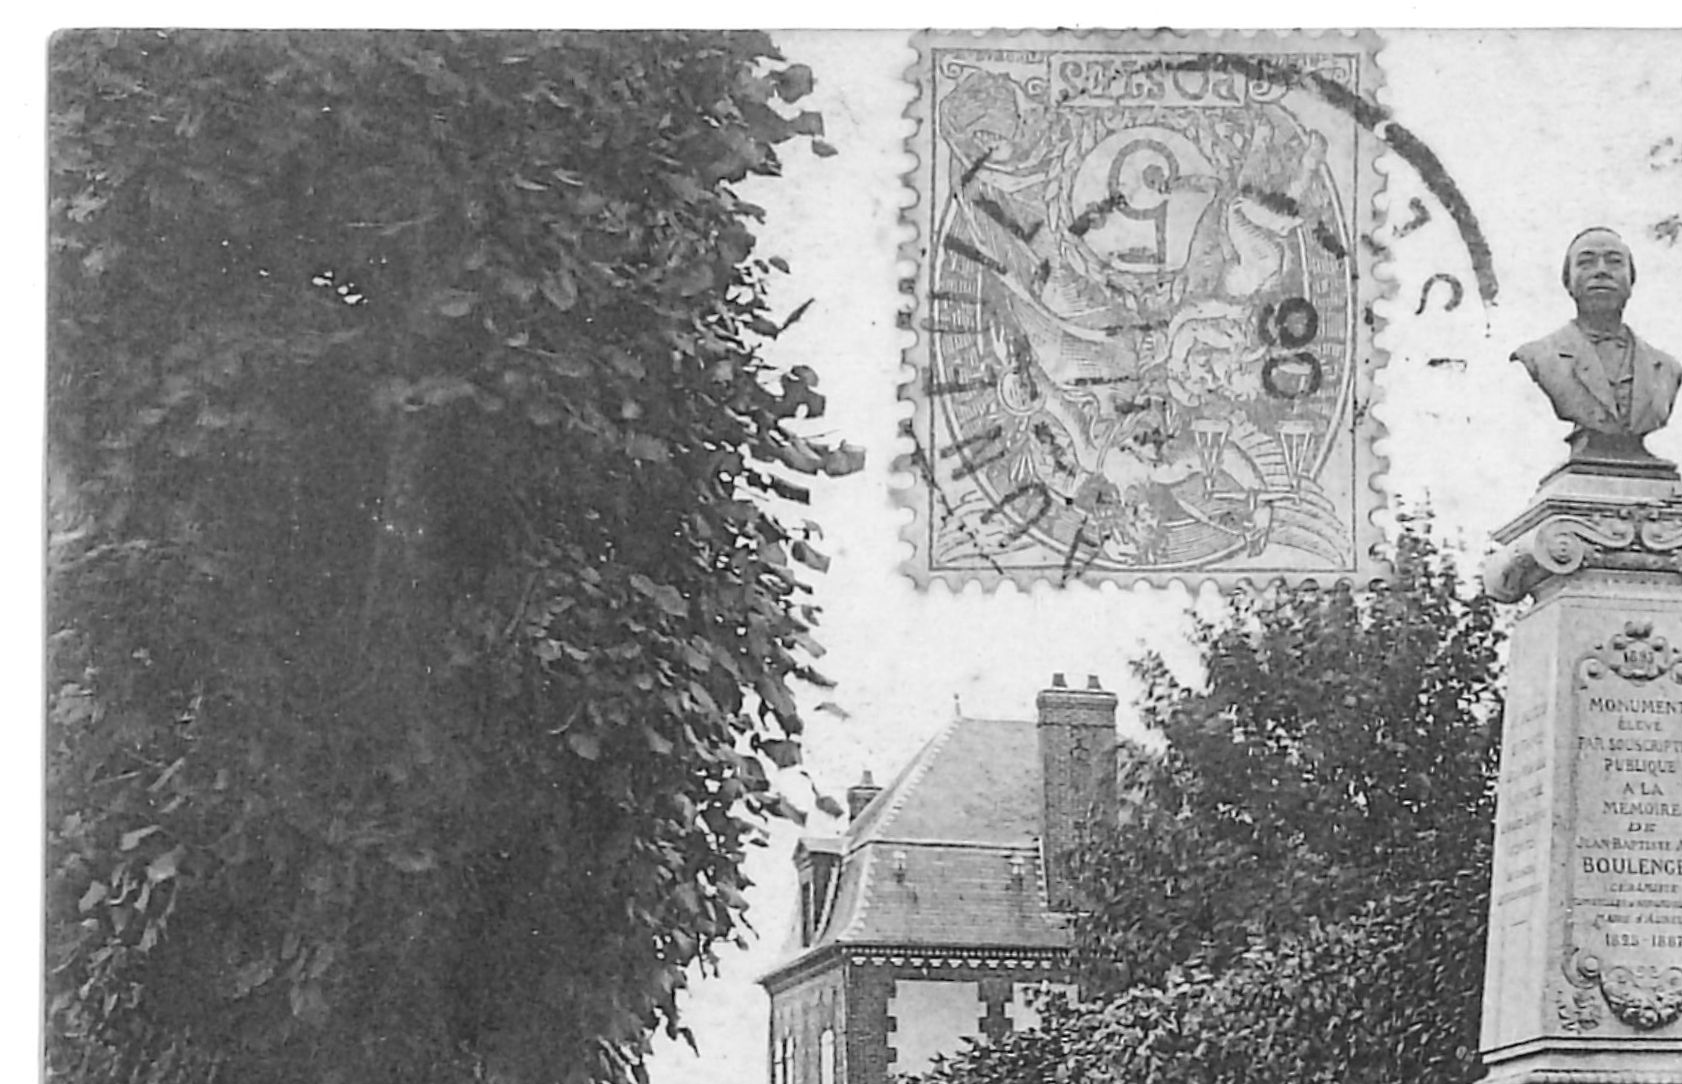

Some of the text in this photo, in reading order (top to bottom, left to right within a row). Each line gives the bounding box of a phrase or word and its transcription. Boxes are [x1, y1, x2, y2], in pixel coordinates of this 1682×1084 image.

[1578, 736, 1604, 750] PAR
[1603, 758, 1676, 777] PUBLIQUE
[1640, 782, 1664, 796] LA
[1627, 821, 1657, 833] DE
